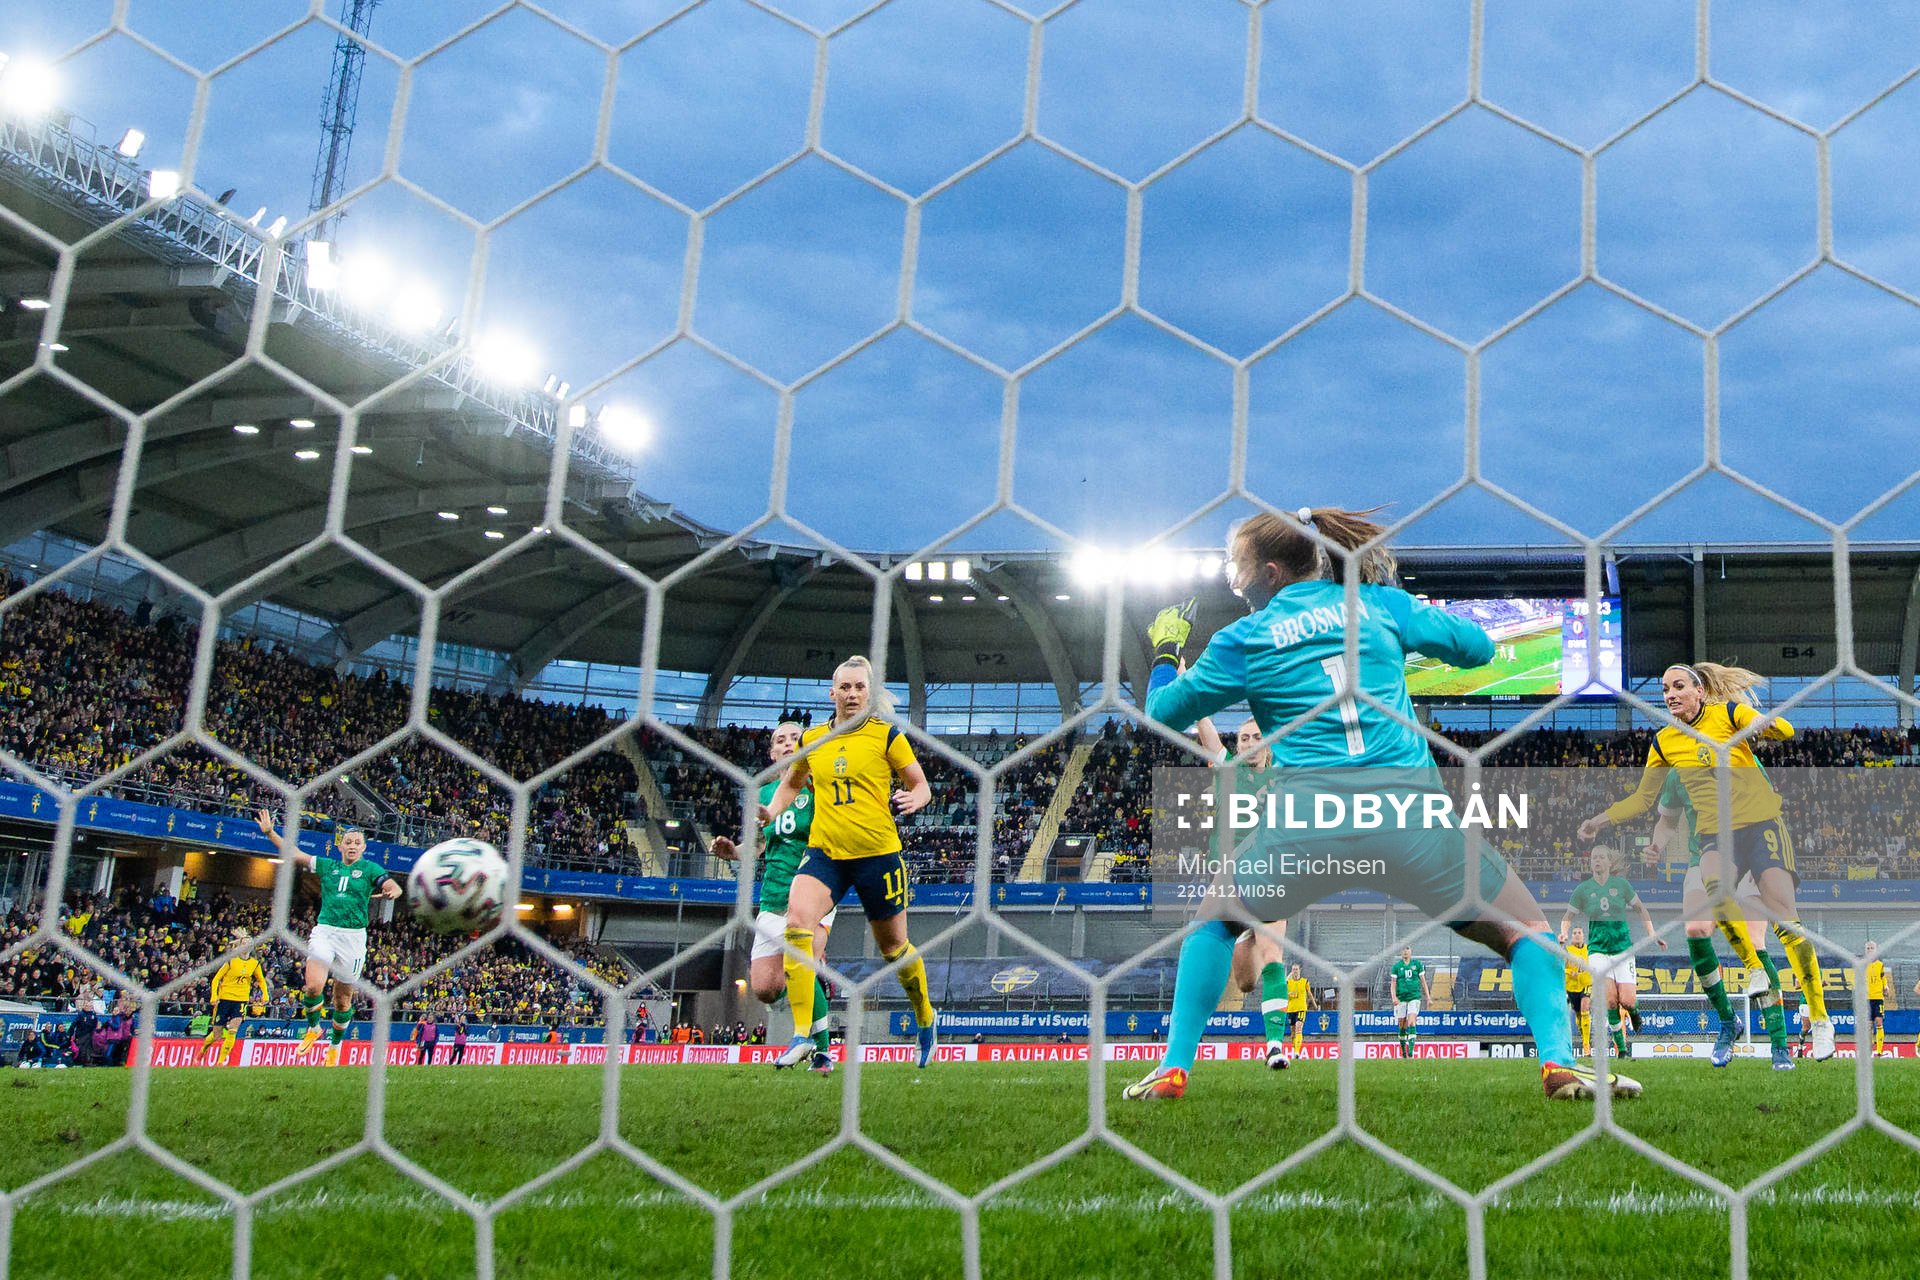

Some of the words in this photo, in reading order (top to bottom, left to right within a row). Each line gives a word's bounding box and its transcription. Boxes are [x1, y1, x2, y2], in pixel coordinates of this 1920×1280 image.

[1573, 620, 1583, 634] 0
[1603, 620, 1610, 633] 1
[975, 653, 1008, 666] P2
[1782, 647, 1816, 659] B4
[1320, 654, 1366, 756] 1
[832, 780, 855, 806] 11
[775, 810, 796, 835] 18
[1763, 829, 1778, 852] 9
[337, 876, 349, 892] 11
[883, 868, 904, 900] 11
[1600, 896, 1609, 911] 8
[353, 958, 361, 973] 11
[1404, 969, 1413, 978] 10
[1021, 1014, 1036, 1026] är
[1038, 1015, 1050, 1026] vi
[1052, 1015, 1092, 1028] Sveri
[1354, 1014, 1440, 1026] Tillsaans
[1442, 1013, 1456, 1026] är
[1460, 1014, 1472, 1026] vi
[1474, 1014, 1527, 1028] Sverige
[350, 1047, 417, 1065] BAAUS
[433, 1046, 495, 1065] BAHAUS
[509, 1048, 562, 1064] BAUHAUS
[575, 1048, 624, 1064] BAUHS
[634, 1049, 678, 1063] BAUHAUS
[688, 1048, 728, 1064] BAUHAUS
[867, 1049, 964, 1062] BAUHUS
[991, 1048, 1088, 1061] BAUHAUS
[1241, 1047, 1339, 1060] BAHAUS
